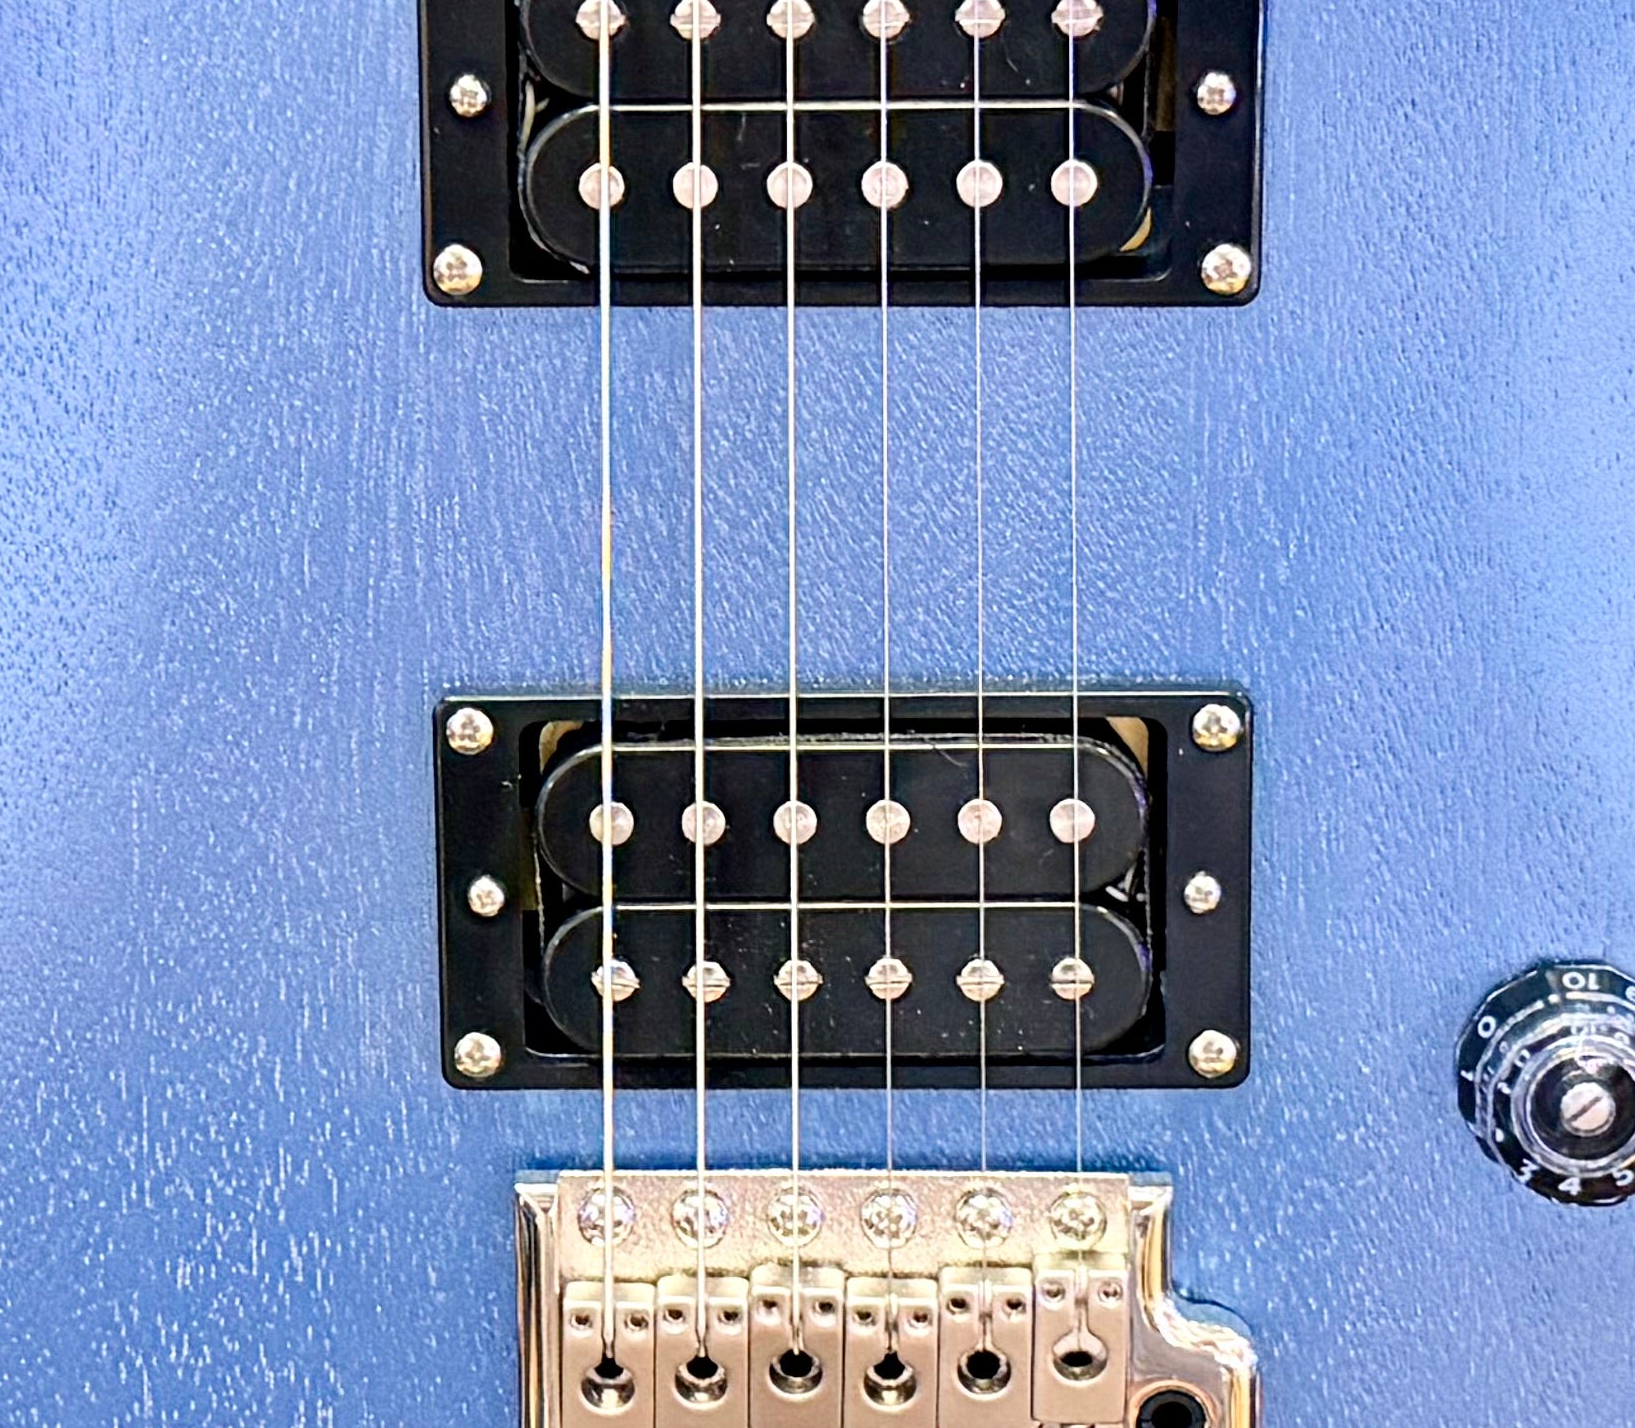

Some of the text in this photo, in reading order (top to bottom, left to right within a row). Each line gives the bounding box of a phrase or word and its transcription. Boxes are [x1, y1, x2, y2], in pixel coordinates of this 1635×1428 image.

[1562, 971, 1600, 990] 10
[1477, 1015, 1496, 1039] 0
[1558, 1177, 1581, 1196] 4
[1612, 1168, 1635, 1187] 5
